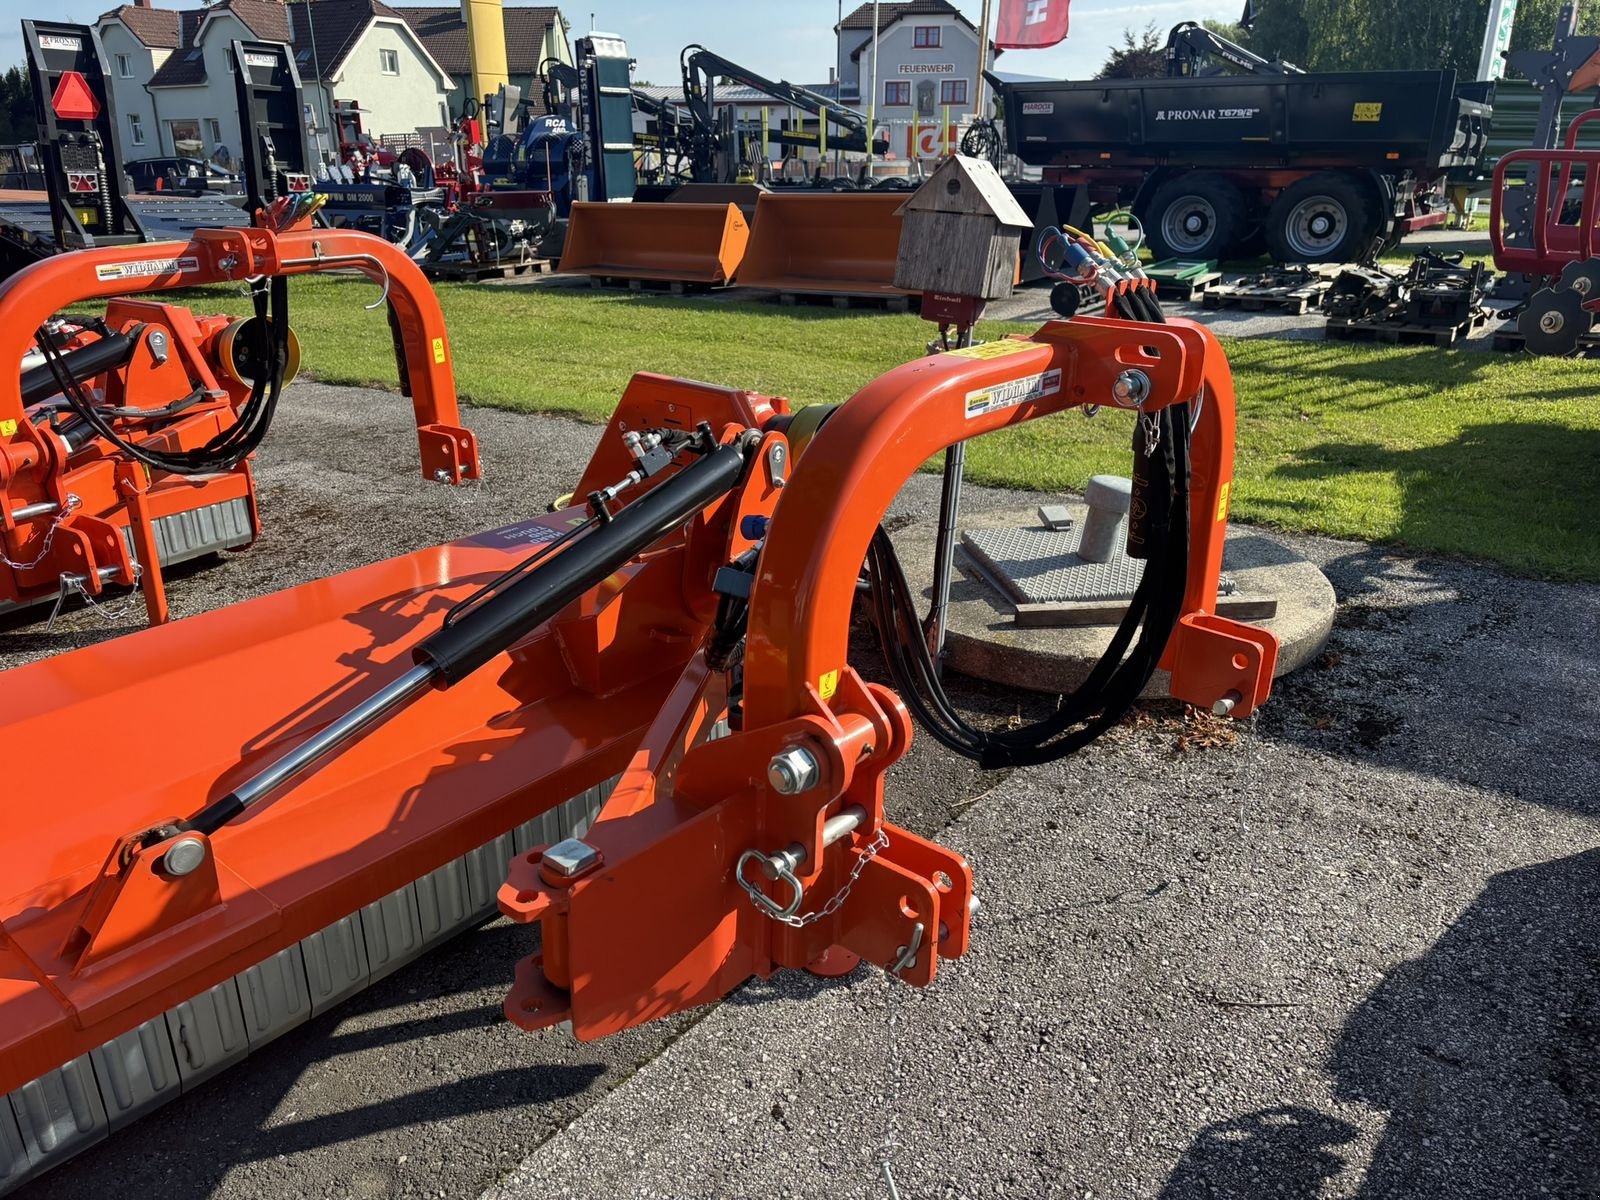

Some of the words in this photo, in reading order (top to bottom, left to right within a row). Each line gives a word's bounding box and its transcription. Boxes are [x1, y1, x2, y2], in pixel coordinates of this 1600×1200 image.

[899, 64, 954, 73] FEUERWEHR
[1167, 109, 1216, 120] PRONAR
[545, 119, 566, 127] RCA
[991, 379, 1041, 405] WIDHALM
